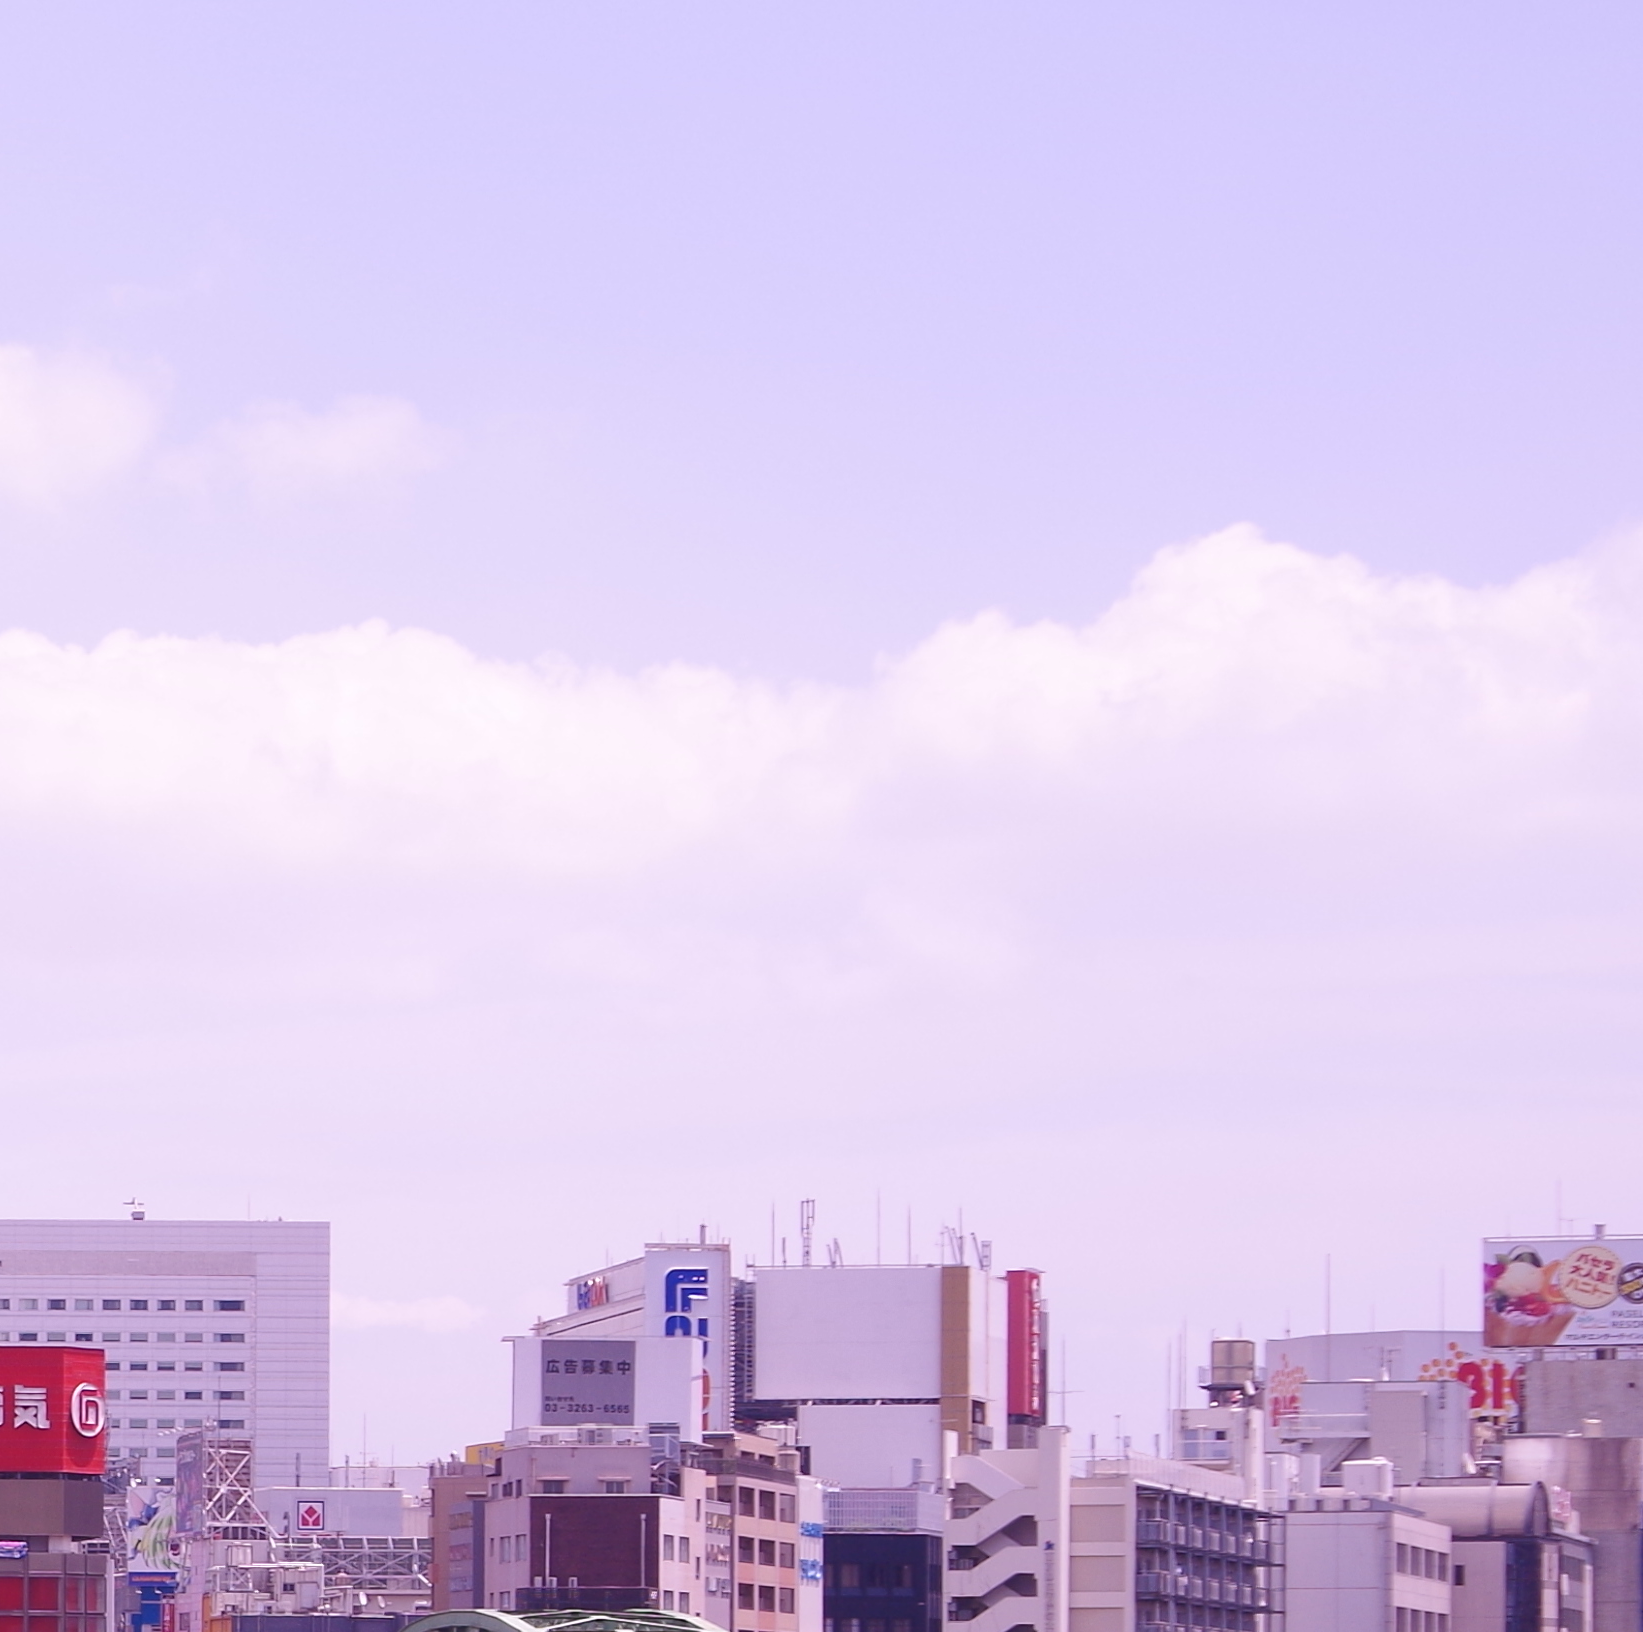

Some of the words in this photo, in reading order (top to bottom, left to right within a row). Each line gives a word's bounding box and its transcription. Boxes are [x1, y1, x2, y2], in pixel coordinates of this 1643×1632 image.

[545, 1359, 632, 1375] 広告募集中
[544, 1403, 630, 1414] 03-3263-6565
